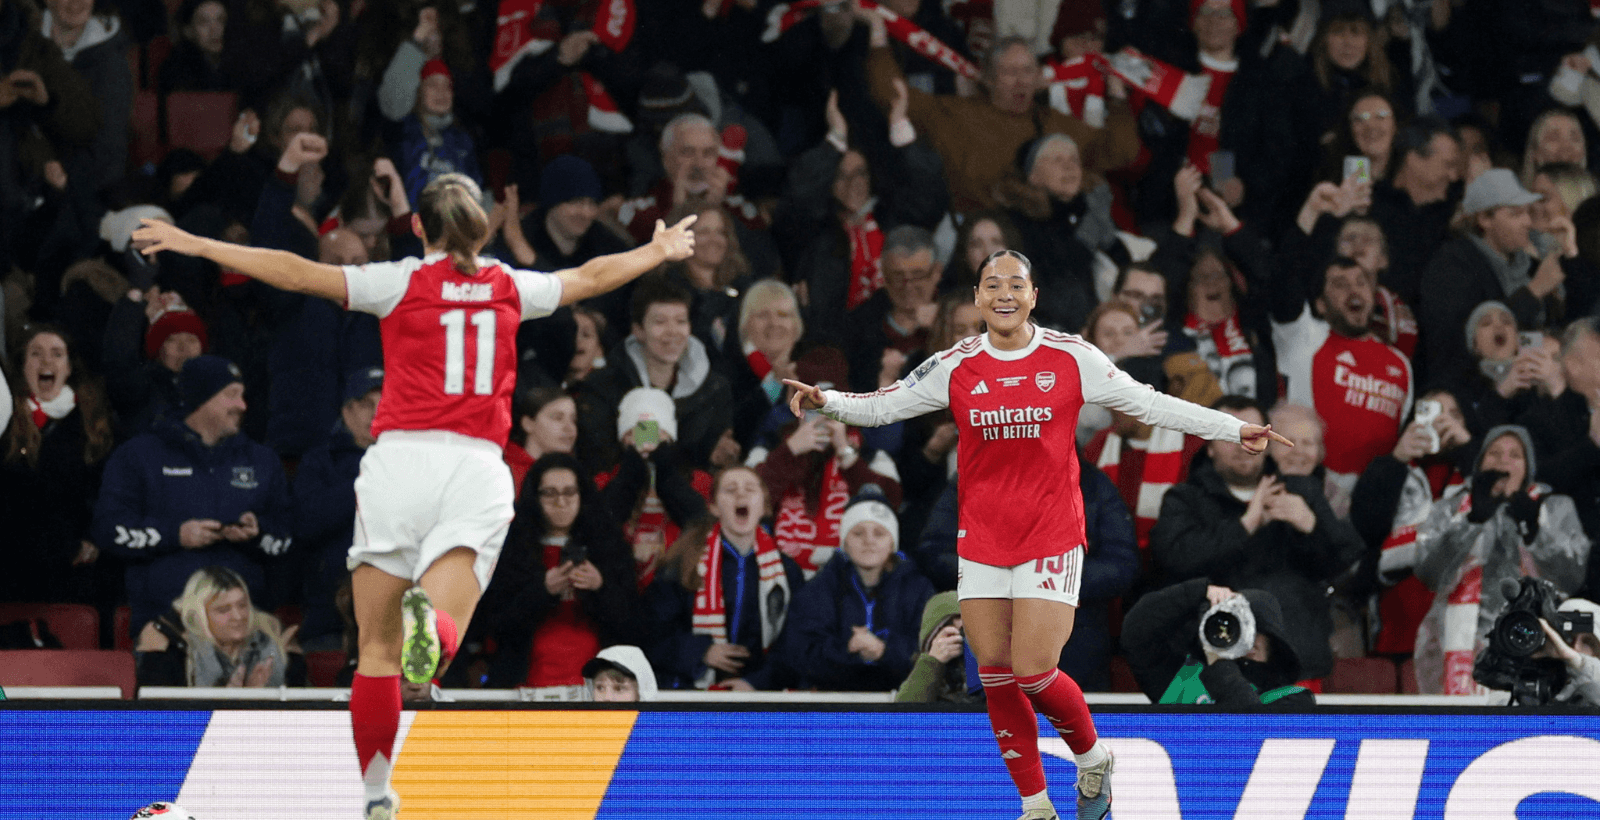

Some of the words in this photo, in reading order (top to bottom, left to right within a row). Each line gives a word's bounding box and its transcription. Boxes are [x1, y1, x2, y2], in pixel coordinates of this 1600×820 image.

[439, 308, 497, 395] 11
[969, 406, 1052, 427] Emirates
[983, 427, 999, 441] FLY
[1002, 423, 1041, 439] BETTER
